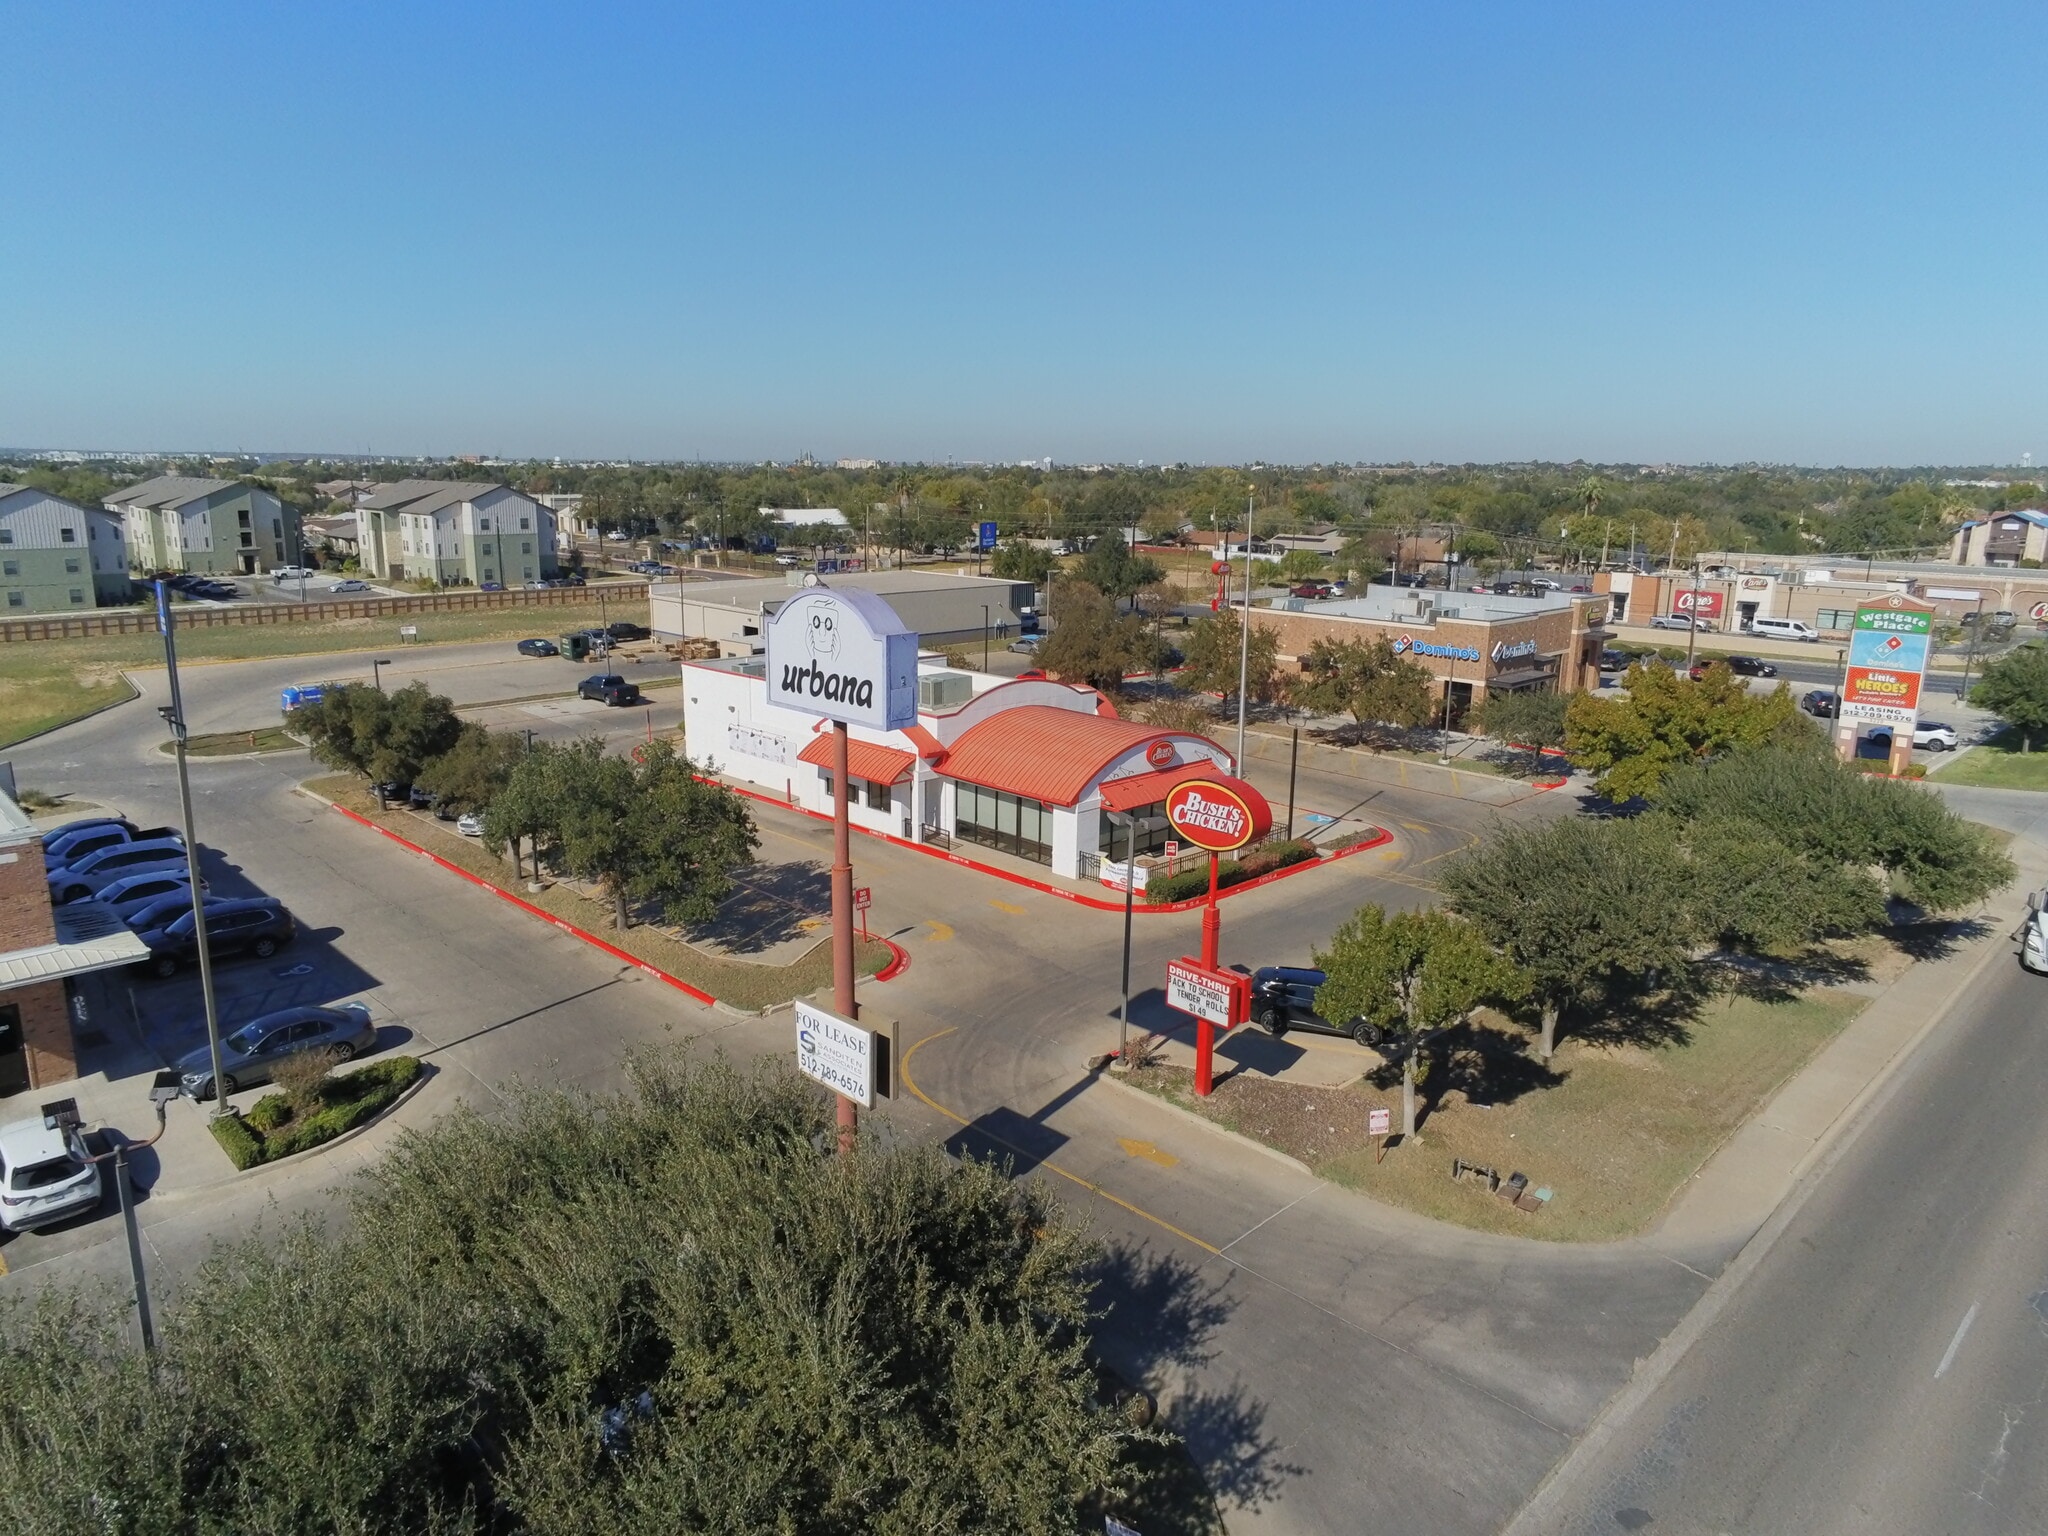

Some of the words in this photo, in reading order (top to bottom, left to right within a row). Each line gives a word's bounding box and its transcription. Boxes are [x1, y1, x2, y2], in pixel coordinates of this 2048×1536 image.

[1860, 612, 1927, 628] Westgate
[1872, 620, 1913, 631] Place
[1412, 639, 1480, 661] Domino's
[781, 658, 873, 709] urbana
[1855, 678, 1909, 695] HEROES
[1868, 672, 1897, 684] Little
[1843, 709, 1912, 722] 512-789-6576
[1854, 705, 1902, 715] LEASING
[1187, 791, 1241, 821] BUSH'S
[1173, 803, 1244, 838] CHICKEN!
[1169, 964, 1230, 994] DRIVE-THRU
[1177, 988, 1201, 1005] TENDER
[1205, 1000, 1230, 1015] ROLLS
[1188, 983, 1197, 992] TO
[1198, 986, 1224, 1004] SCHOOL
[796, 1011, 821, 1034] FOR
[825, 1024, 867, 1056] LEASE
[818, 1042, 863, 1069] SANDITEN
[801, 1053, 865, 1098] 512-789-6576
